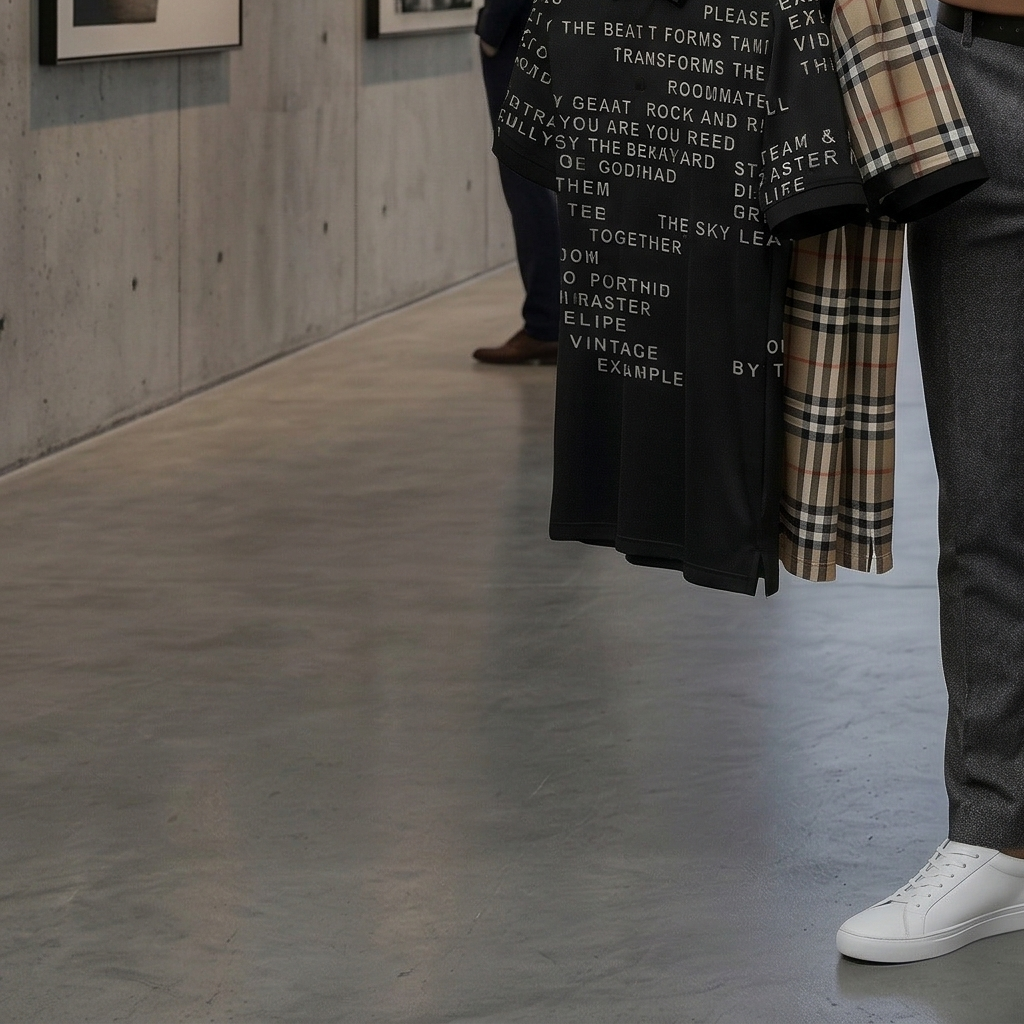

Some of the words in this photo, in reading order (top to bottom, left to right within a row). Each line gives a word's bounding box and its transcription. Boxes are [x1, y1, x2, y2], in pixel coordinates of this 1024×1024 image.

[703, 4, 770, 27] PLEASE
[561, 20, 596, 36] THE
[664, 27, 722, 49] FORMS
[613, 46, 724, 76] TRANSFORMS
[732, 62, 765, 81] THE
[572, 96, 631, 115] GEAAT
[646, 102, 694, 123] ROCK
[700, 110, 737, 128] AND
[588, 137, 621, 155] THE
[606, 119, 640, 137] ARE
[646, 123, 680, 143] YOU
[687, 130, 736, 151] REED
[821, 128, 836, 144] &
[555, 176, 610, 197] THEM
[657, 213, 688, 234] THE
[695, 221, 731, 241] SKY
[589, 228, 682, 256] TOGETHER
[564, 310, 627, 333] ELIPE
[569, 334, 659, 361] VINTAGE
[732, 360, 759, 378] BY
